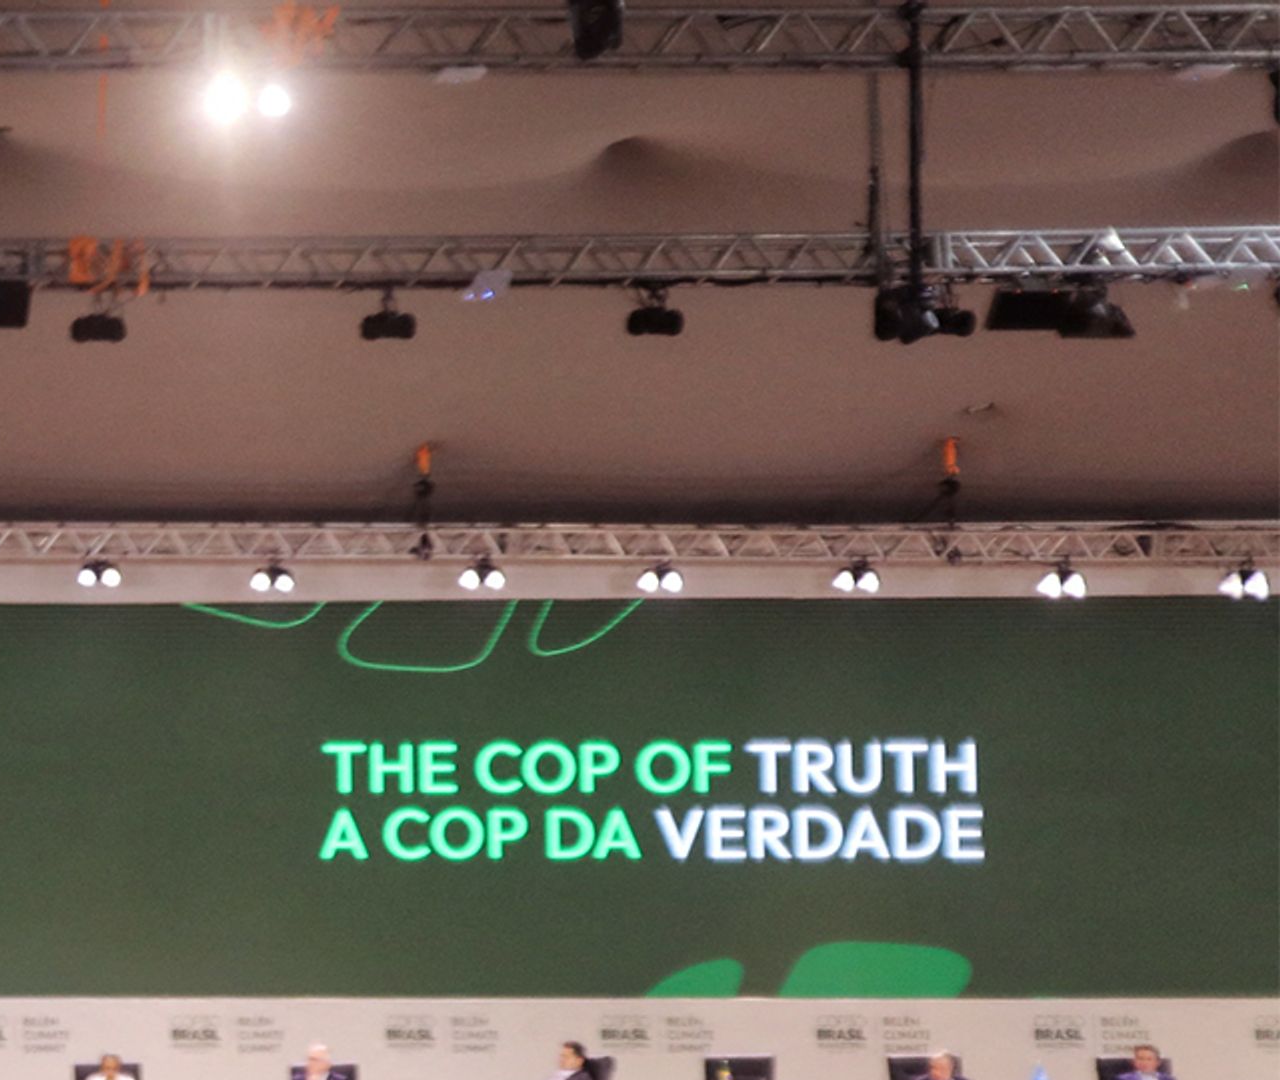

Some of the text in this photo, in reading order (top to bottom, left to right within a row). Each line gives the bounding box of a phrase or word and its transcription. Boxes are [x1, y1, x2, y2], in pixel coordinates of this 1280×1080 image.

[320, 738, 978, 796] THE COP OF TRUTH
[319, 804, 986, 862] A COP DA VERDADE
[172, 1029, 222, 1041] BRASIL
[386, 1029, 435, 1041] BRASIL
[601, 1029, 650, 1041] BRASIL
[816, 1029, 866, 1041] BRASIL
[1034, 1029, 1086, 1041] BRASIL
